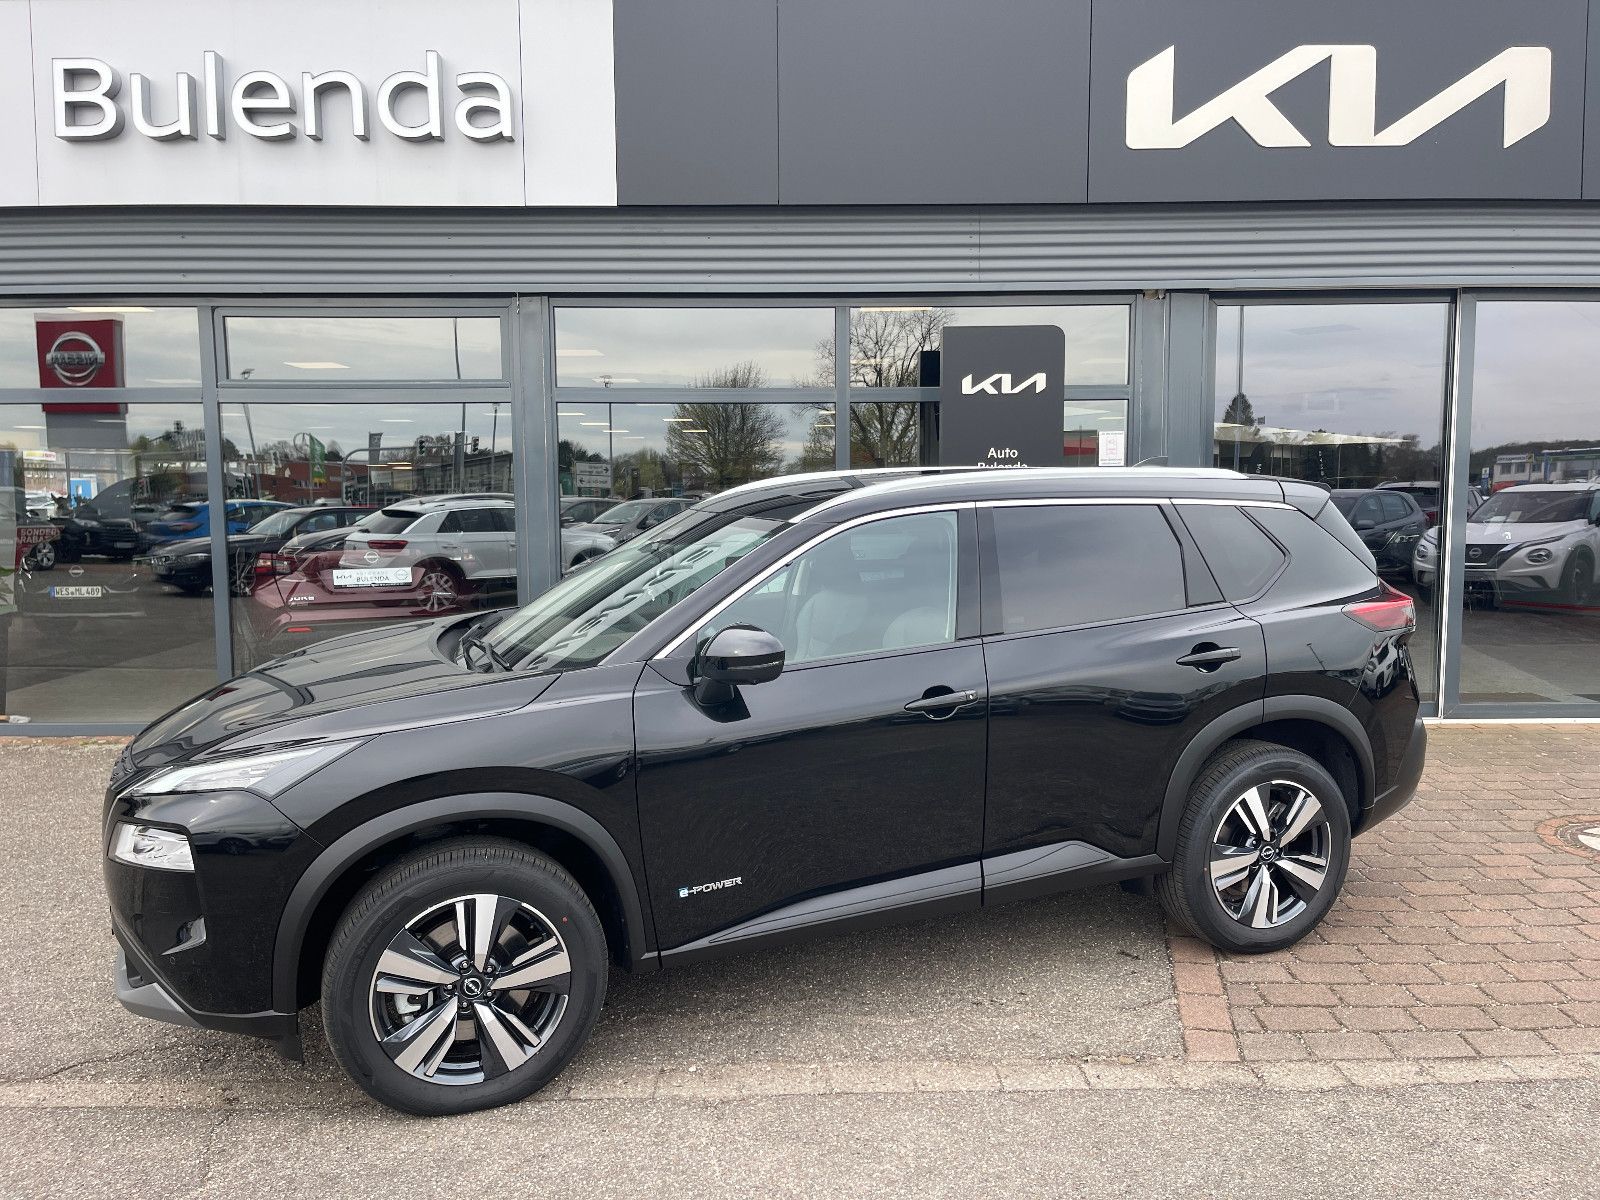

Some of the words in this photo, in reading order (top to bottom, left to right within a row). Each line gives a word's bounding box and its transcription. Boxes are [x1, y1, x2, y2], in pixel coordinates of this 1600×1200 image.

[52, 50, 514, 141] Bulenda
[1126, 44, 1551, 149] KIA
[961, 372, 1046, 394] KIA
[987, 447, 1019, 458] Auto
